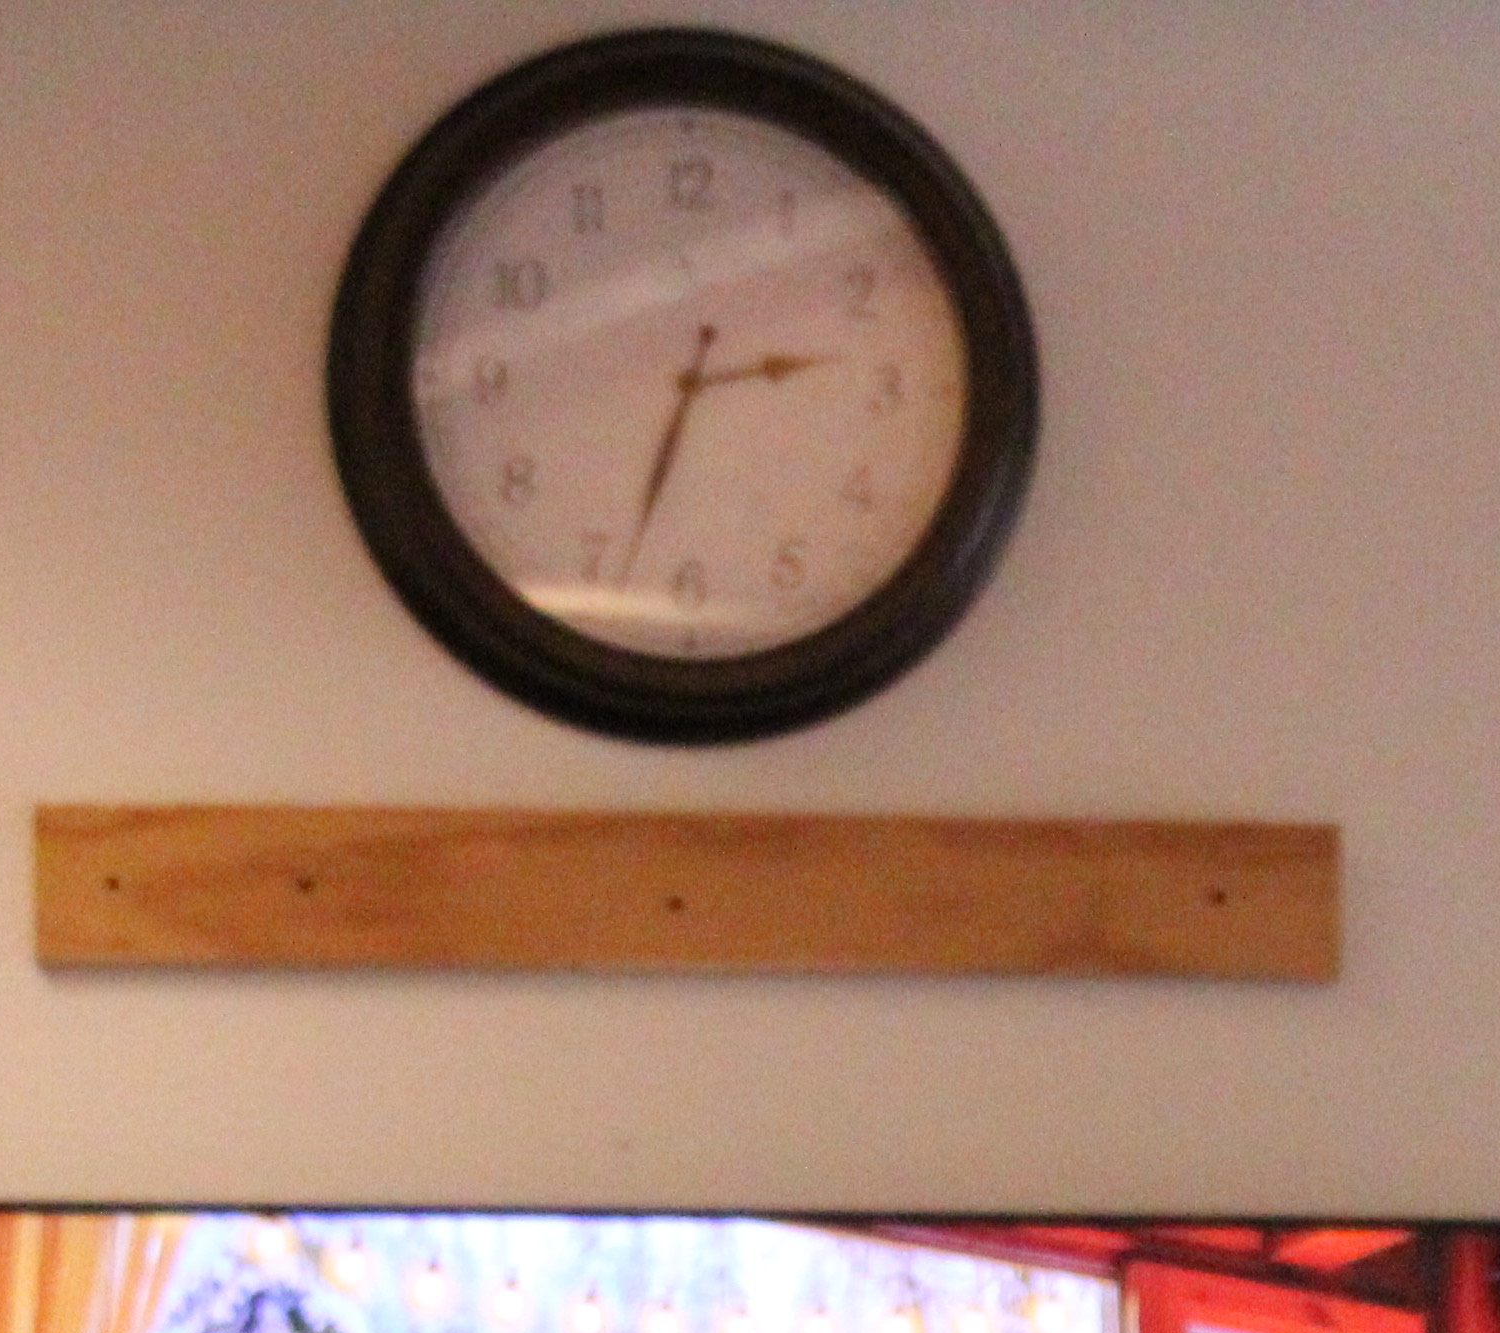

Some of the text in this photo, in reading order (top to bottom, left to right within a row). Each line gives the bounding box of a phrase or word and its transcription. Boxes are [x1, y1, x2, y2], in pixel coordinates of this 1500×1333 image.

[667, 157, 714, 210] 12
[571, 185, 603, 233] 11
[777, 189, 796, 232] 1
[493, 258, 550, 310] 10
[844, 263, 875, 317] 2
[475, 356, 508, 404] 9
[868, 363, 902, 414] 3
[502, 456, 536, 506] 8
[839, 465, 872, 510] 4
[581, 530, 610, 582] 7
[771, 541, 807, 589] 5
[673, 560, 705, 604] 6
